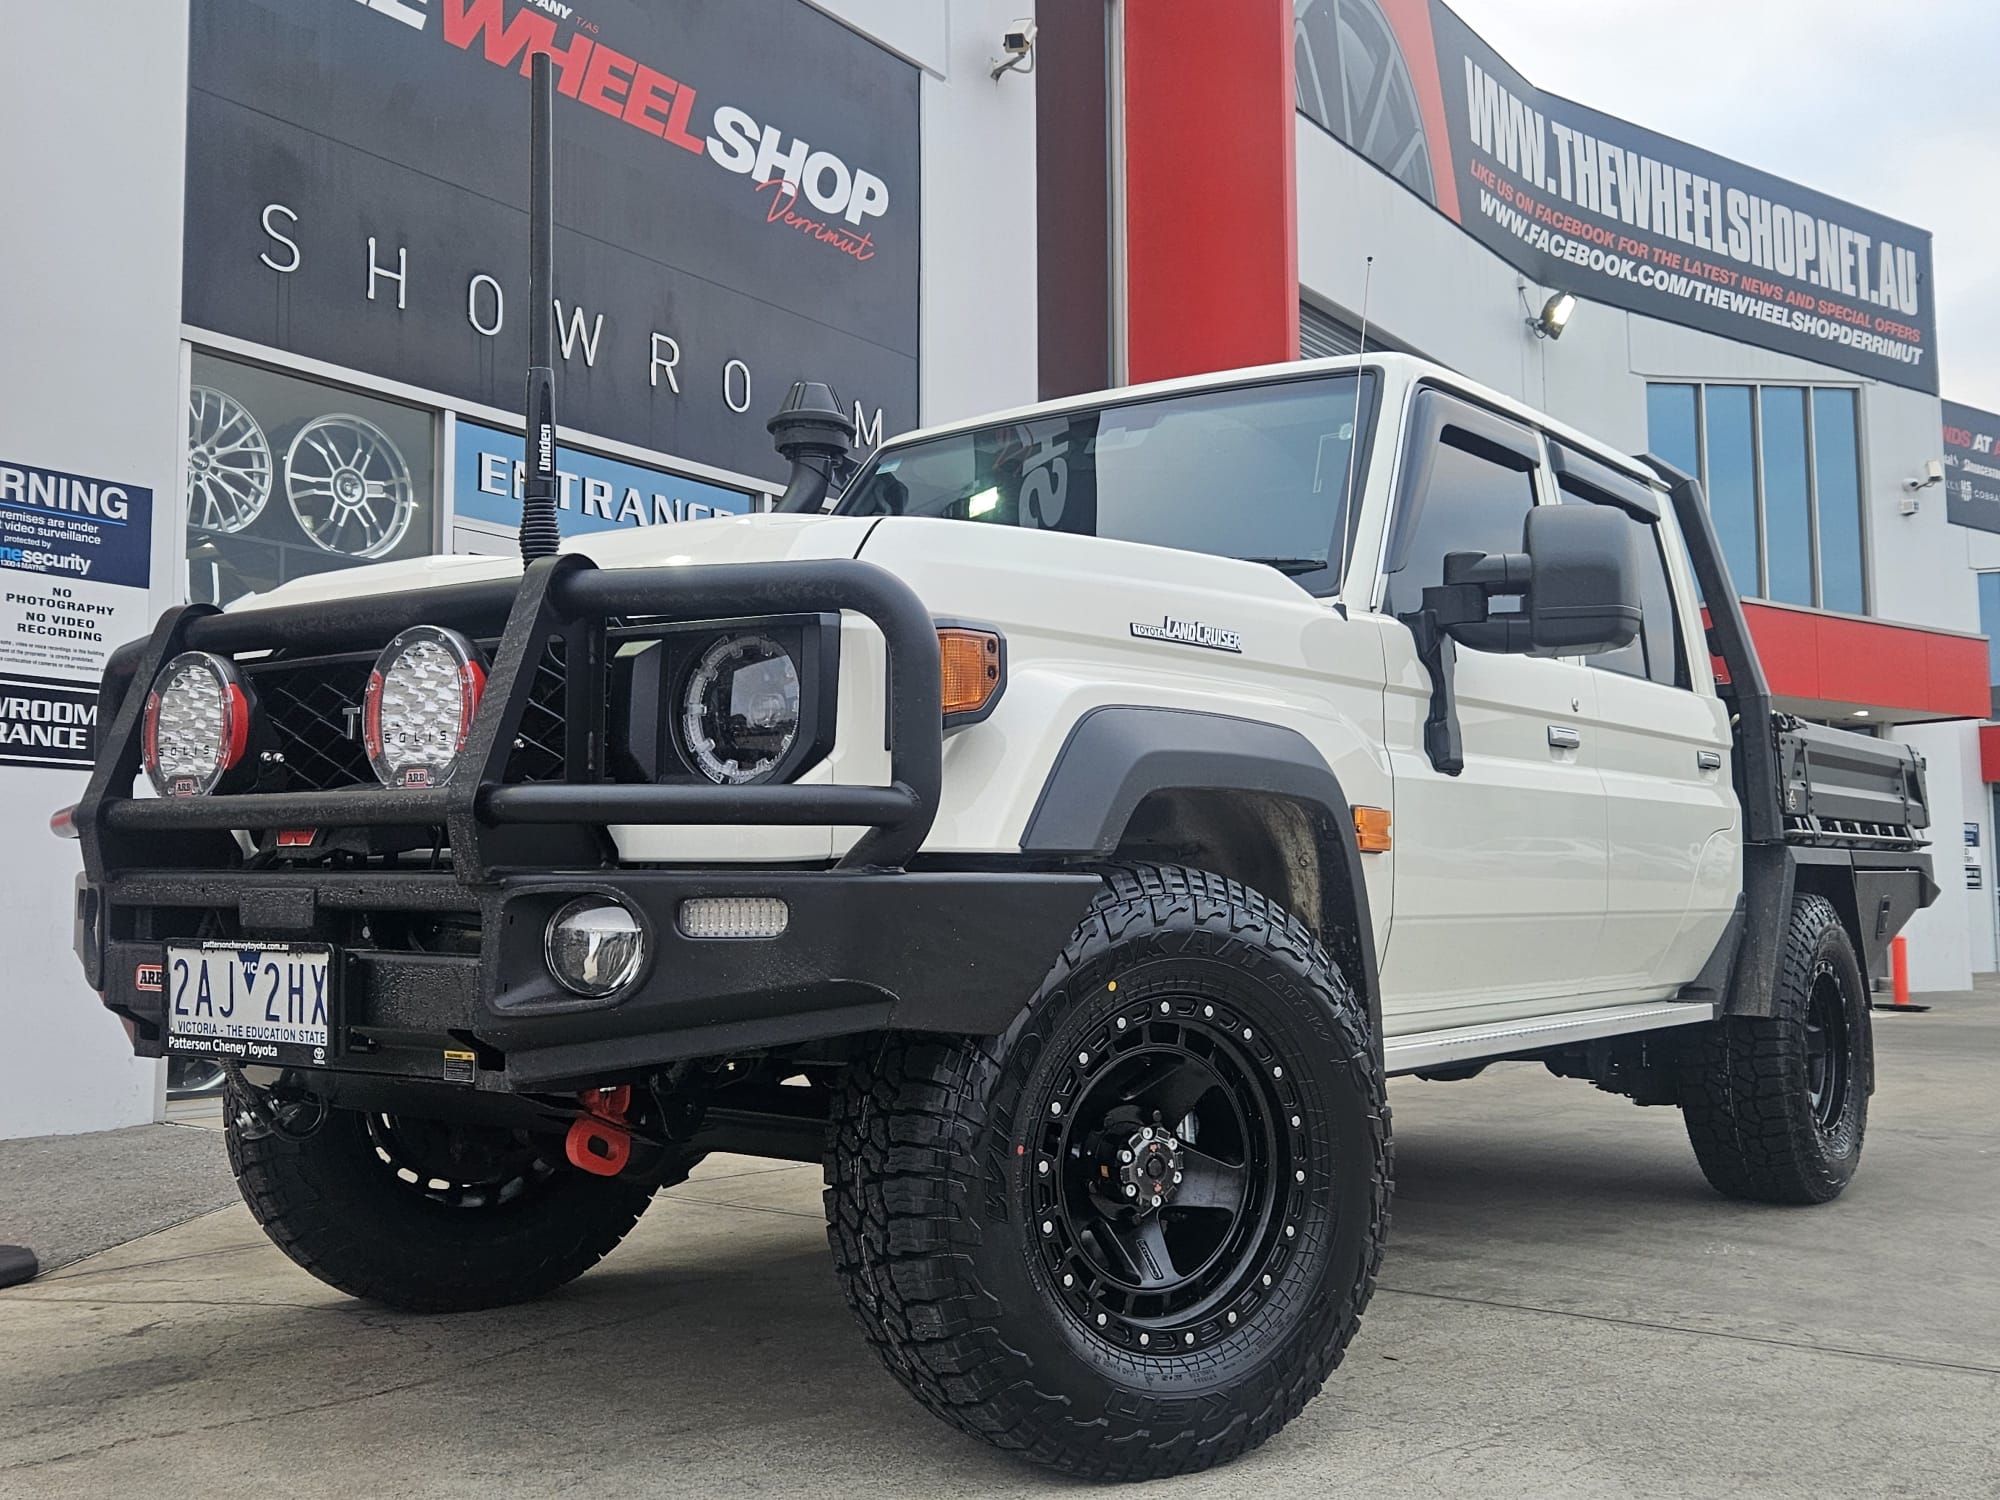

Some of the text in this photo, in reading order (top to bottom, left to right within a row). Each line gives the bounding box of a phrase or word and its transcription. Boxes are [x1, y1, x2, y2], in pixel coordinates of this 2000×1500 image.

[526, 0, 573, 20] ANY
[706, 106, 889, 226] SHOP
[1464, 55, 1918, 316] WWW.THEWHEELSHOP.NET.AU
[1470, 159, 1921, 343] LIKE US ON FACEBOOK FOR THE LATEST NEWS AND SPECIAL OFFERS
[1480, 188, 1924, 366] WWW.FACEBOOK.COM/THEWHEELSHOPDERRIMUT
[260, 203, 884, 451] SHOWROM
[538, 423, 551, 472] Uniden
[1972, 433, 1993, 454] AT
[0, 466, 129, 521] RNING
[0, 511, 45, 526] remises
[47, 518, 65, 529] are
[67, 521, 100, 534] under
[4, 520, 35, 535] video
[37, 526, 101, 545] surveillance
[4, 535, 52, 550] protected by
[52, 587, 72, 598] NO
[6, 593, 115, 616] PHOTOGRAPHY
[26, 611, 95, 629] NO VIDEO
[1134, 624, 1164, 637] TOYOTA
[17, 623, 102, 642] RECORDING
[384, 730, 447, 744] SOLIS
[158, 745, 210, 757] SOLIS
[176, 782, 191, 792] ARB
[407, 772, 425, 783] ARB
[173, 958, 328, 1027] 2AJ VIC 2HX
[178, 1020, 218, 1035] VICTORIA
[227, 1024, 243, 1038] THE
[246, 1026, 296, 1042] EDUCATION
[299, 1030, 326, 1045] STATE
[168, 1036, 277, 1059] Patterson Cheney Toyota
